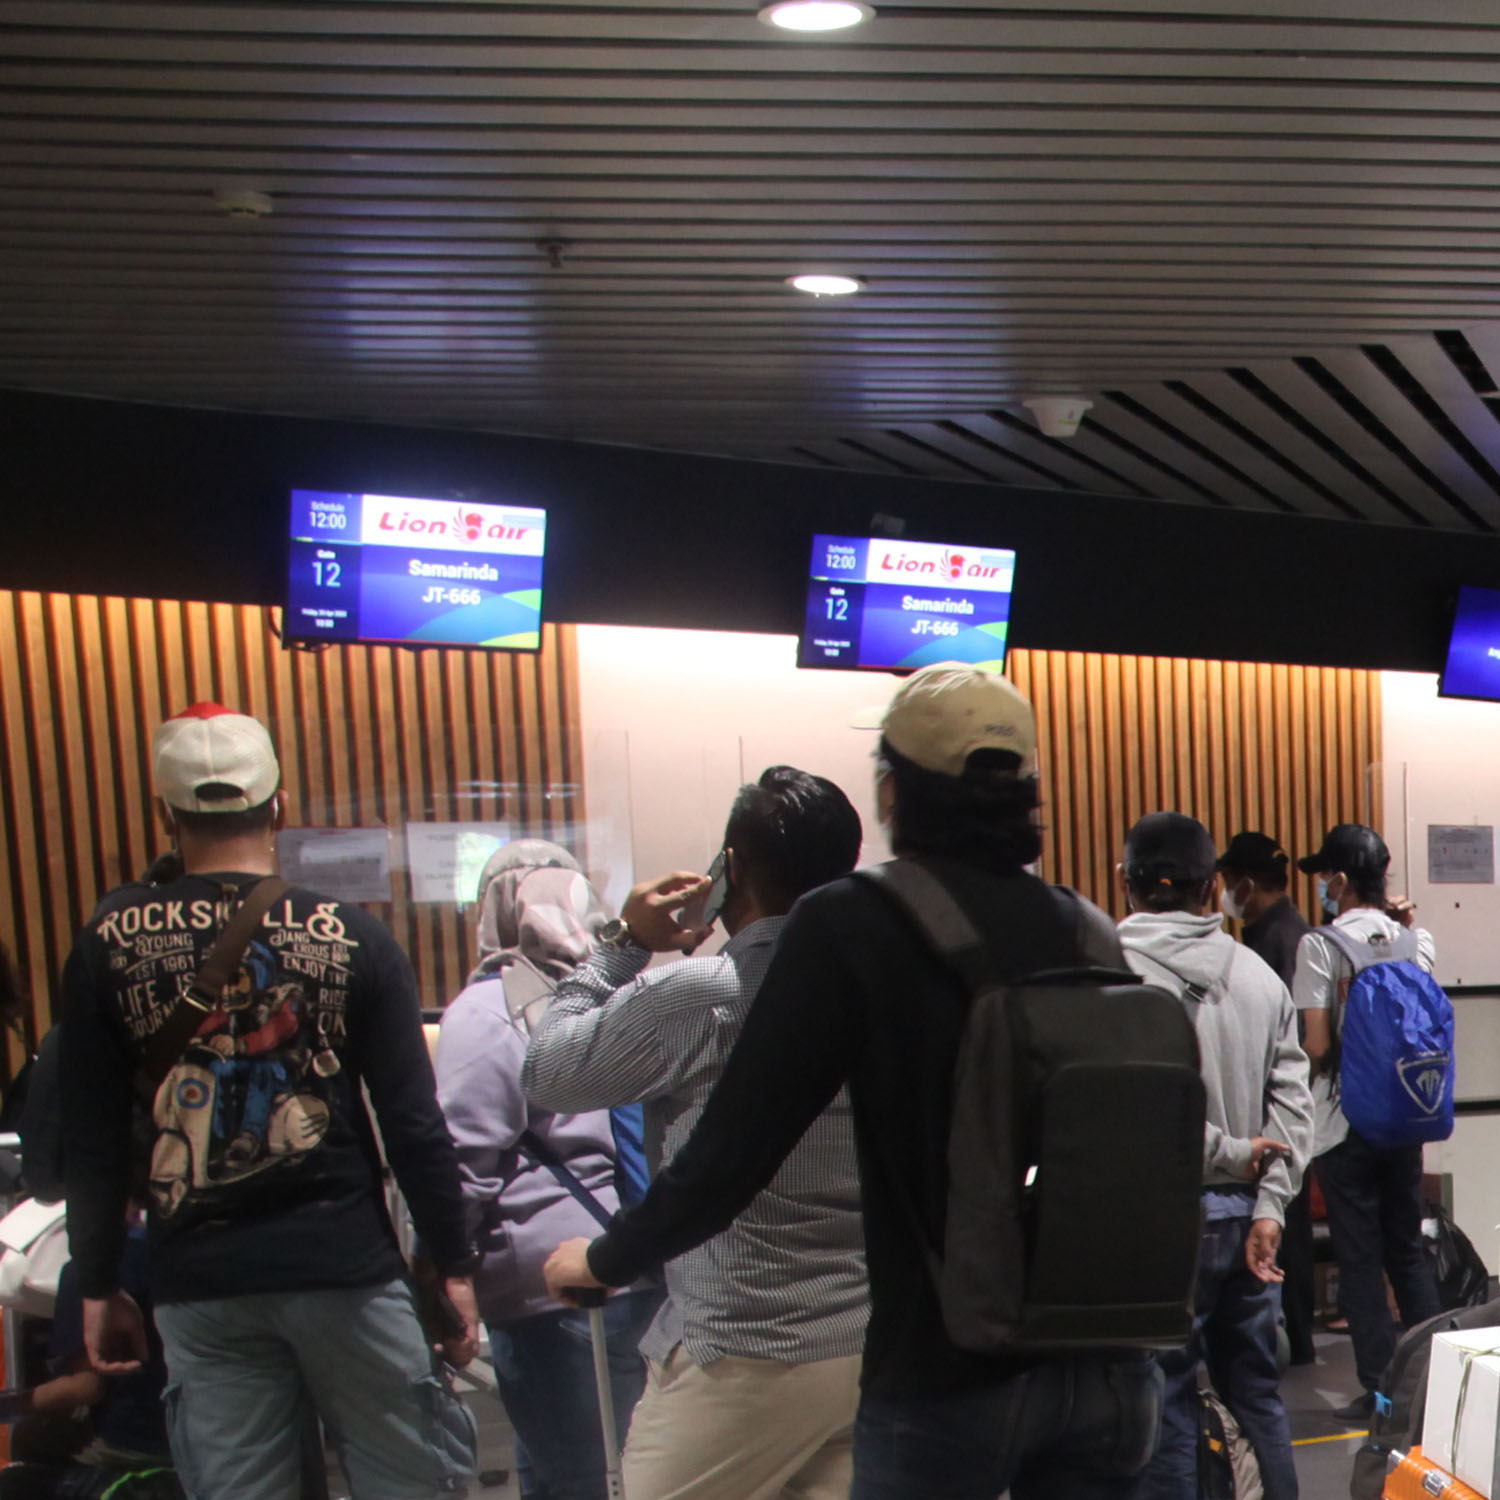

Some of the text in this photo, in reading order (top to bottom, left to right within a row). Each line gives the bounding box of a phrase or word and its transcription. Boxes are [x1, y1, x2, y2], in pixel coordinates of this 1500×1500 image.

[309, 511, 346, 529] 12:00
[378, 512, 528, 540] Lion air
[408, 559, 499, 581] Samarinda
[826, 554, 856, 569] 12:00
[881, 554, 999, 578] Lion air
[312, 561, 341, 587] 12
[422, 586, 481, 605] JT-666
[902, 595, 974, 614] Samarinda
[825, 598, 848, 620] 12
[911, 619, 959, 636] JT-666
[282, 955, 327, 983] ENJOY
[117, 980, 160, 1019] LIFE
